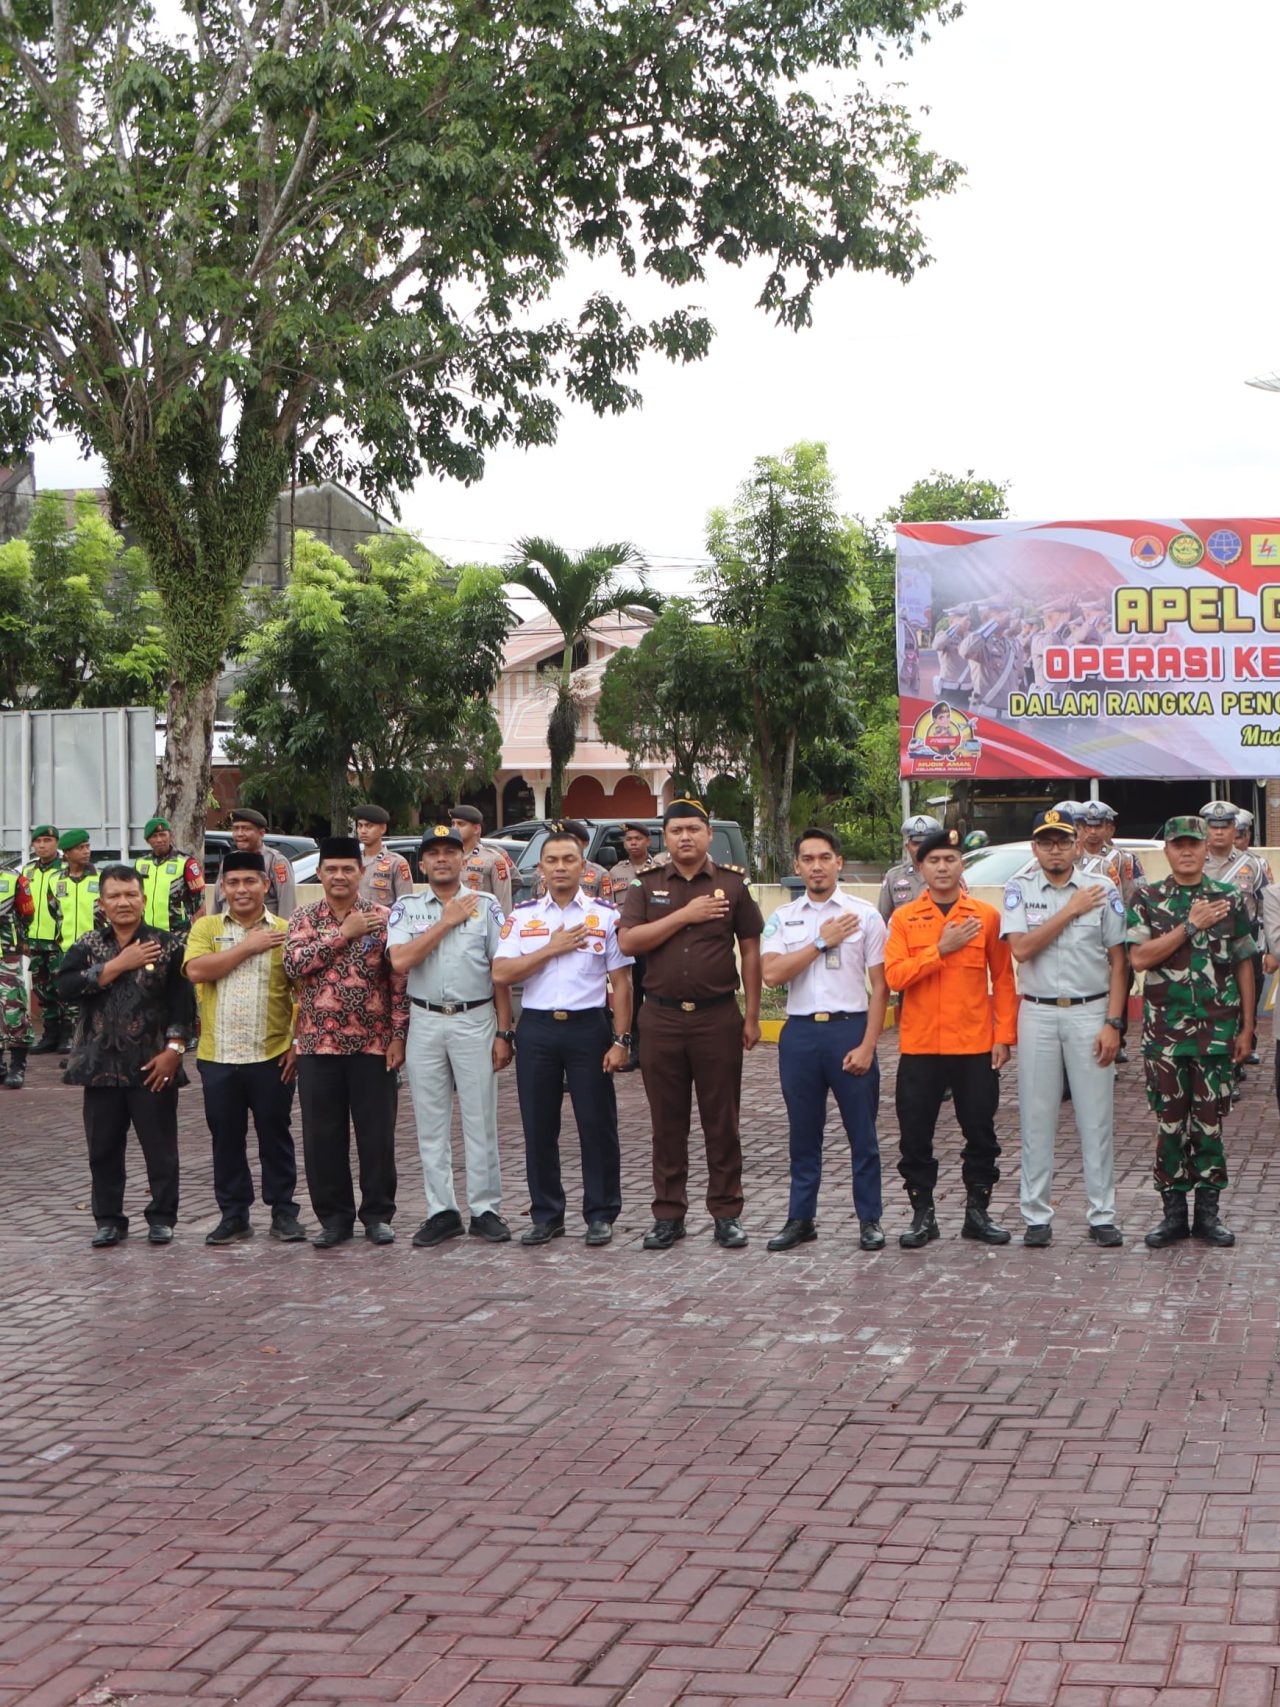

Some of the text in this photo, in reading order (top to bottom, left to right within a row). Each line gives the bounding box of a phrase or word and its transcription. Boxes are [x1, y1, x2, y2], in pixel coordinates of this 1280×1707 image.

[1115, 586, 1255, 633] APEL
[1045, 646, 1221, 679] OPERASI
[1010, 693, 1099, 717] DALAM
[1106, 692, 1213, 716] RANGKA
